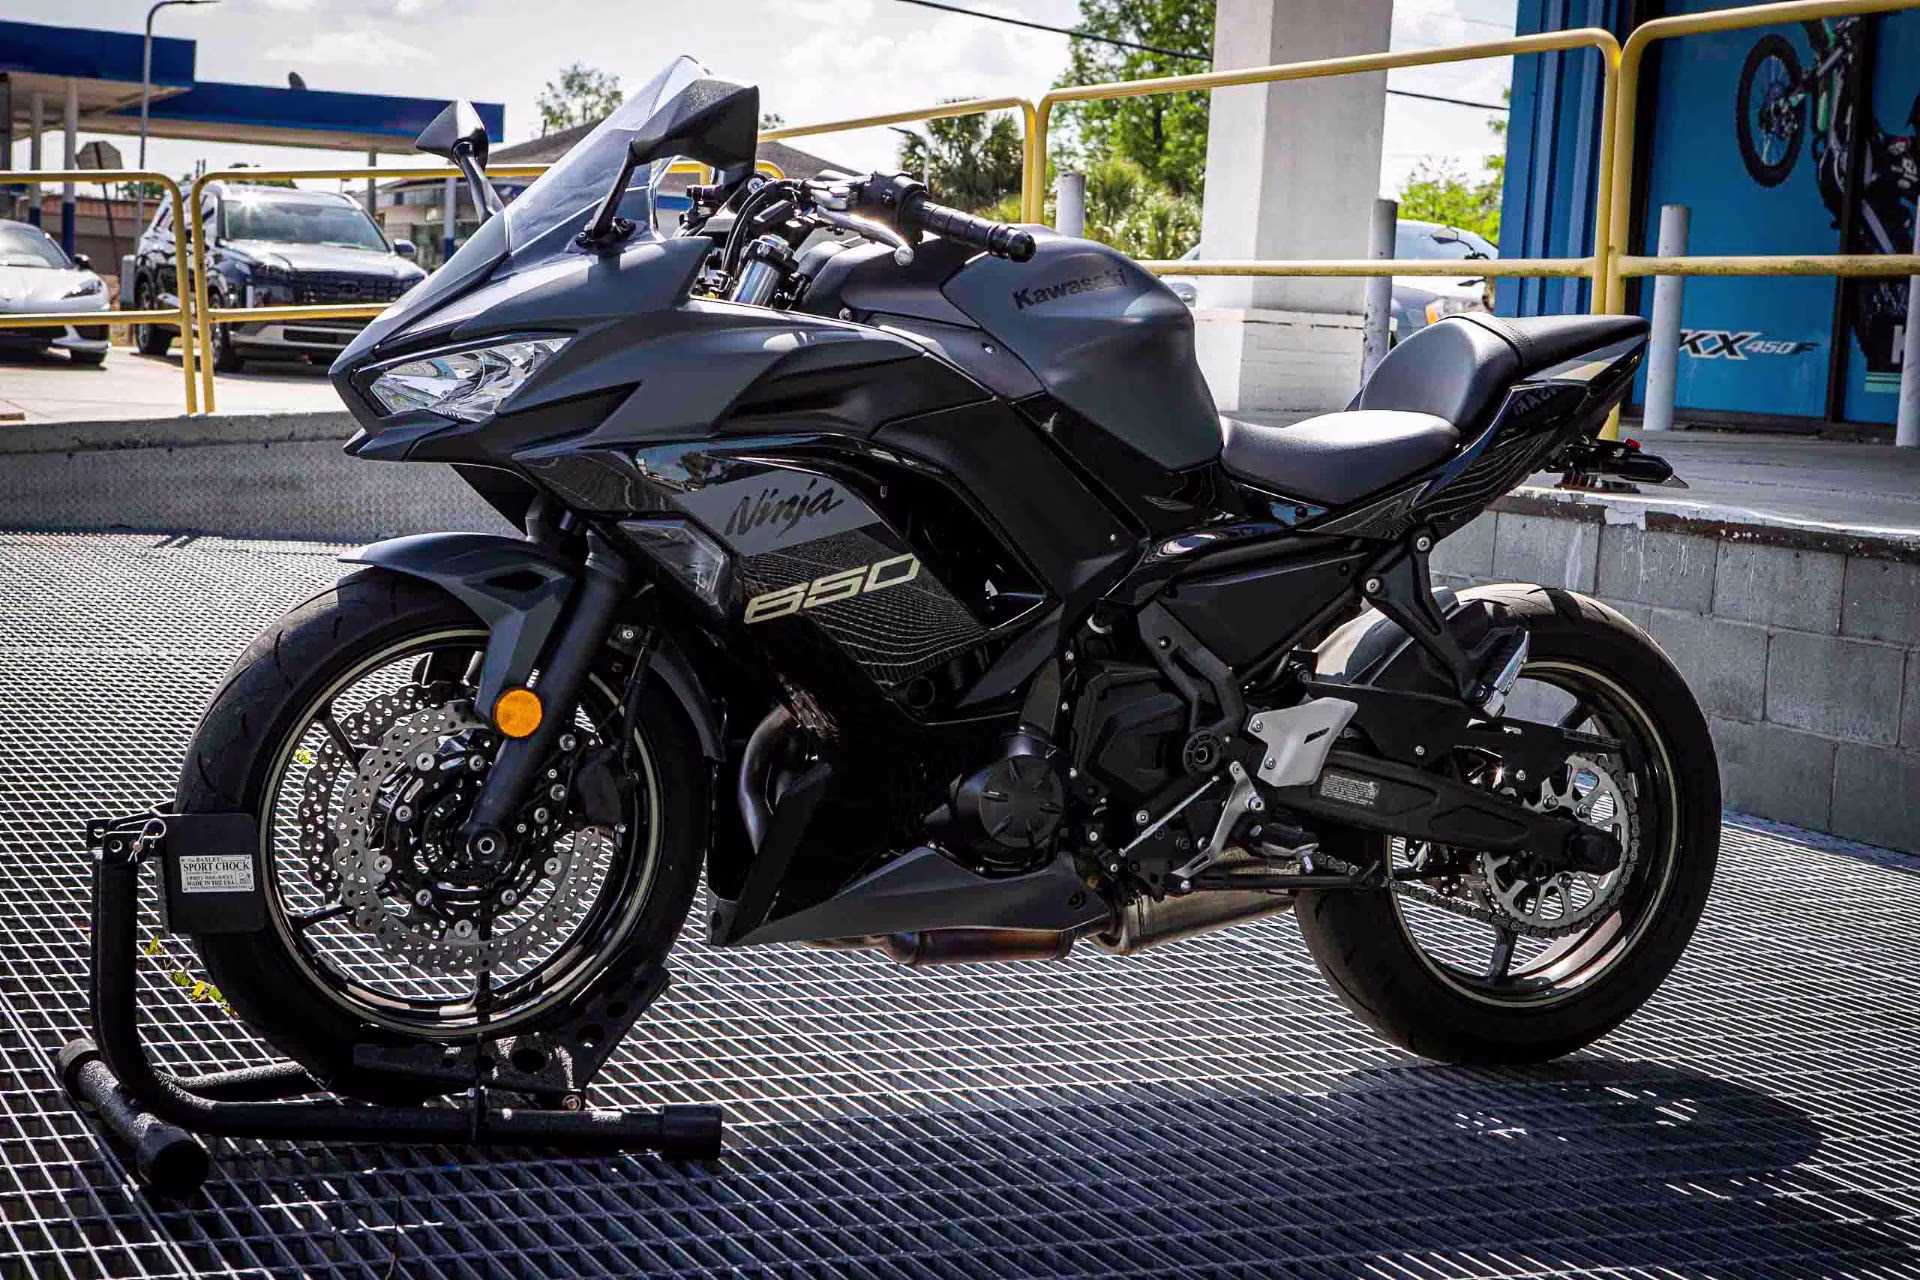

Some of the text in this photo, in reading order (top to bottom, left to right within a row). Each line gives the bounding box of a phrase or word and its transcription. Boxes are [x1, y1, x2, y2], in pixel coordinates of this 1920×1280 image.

[1013, 267, 1127, 309] Kawasi
[1679, 329, 1762, 360] KX
[725, 478, 844, 538] Ninja
[744, 553, 920, 624] 650
[184, 861, 250, 871] SPORT CHOCK
